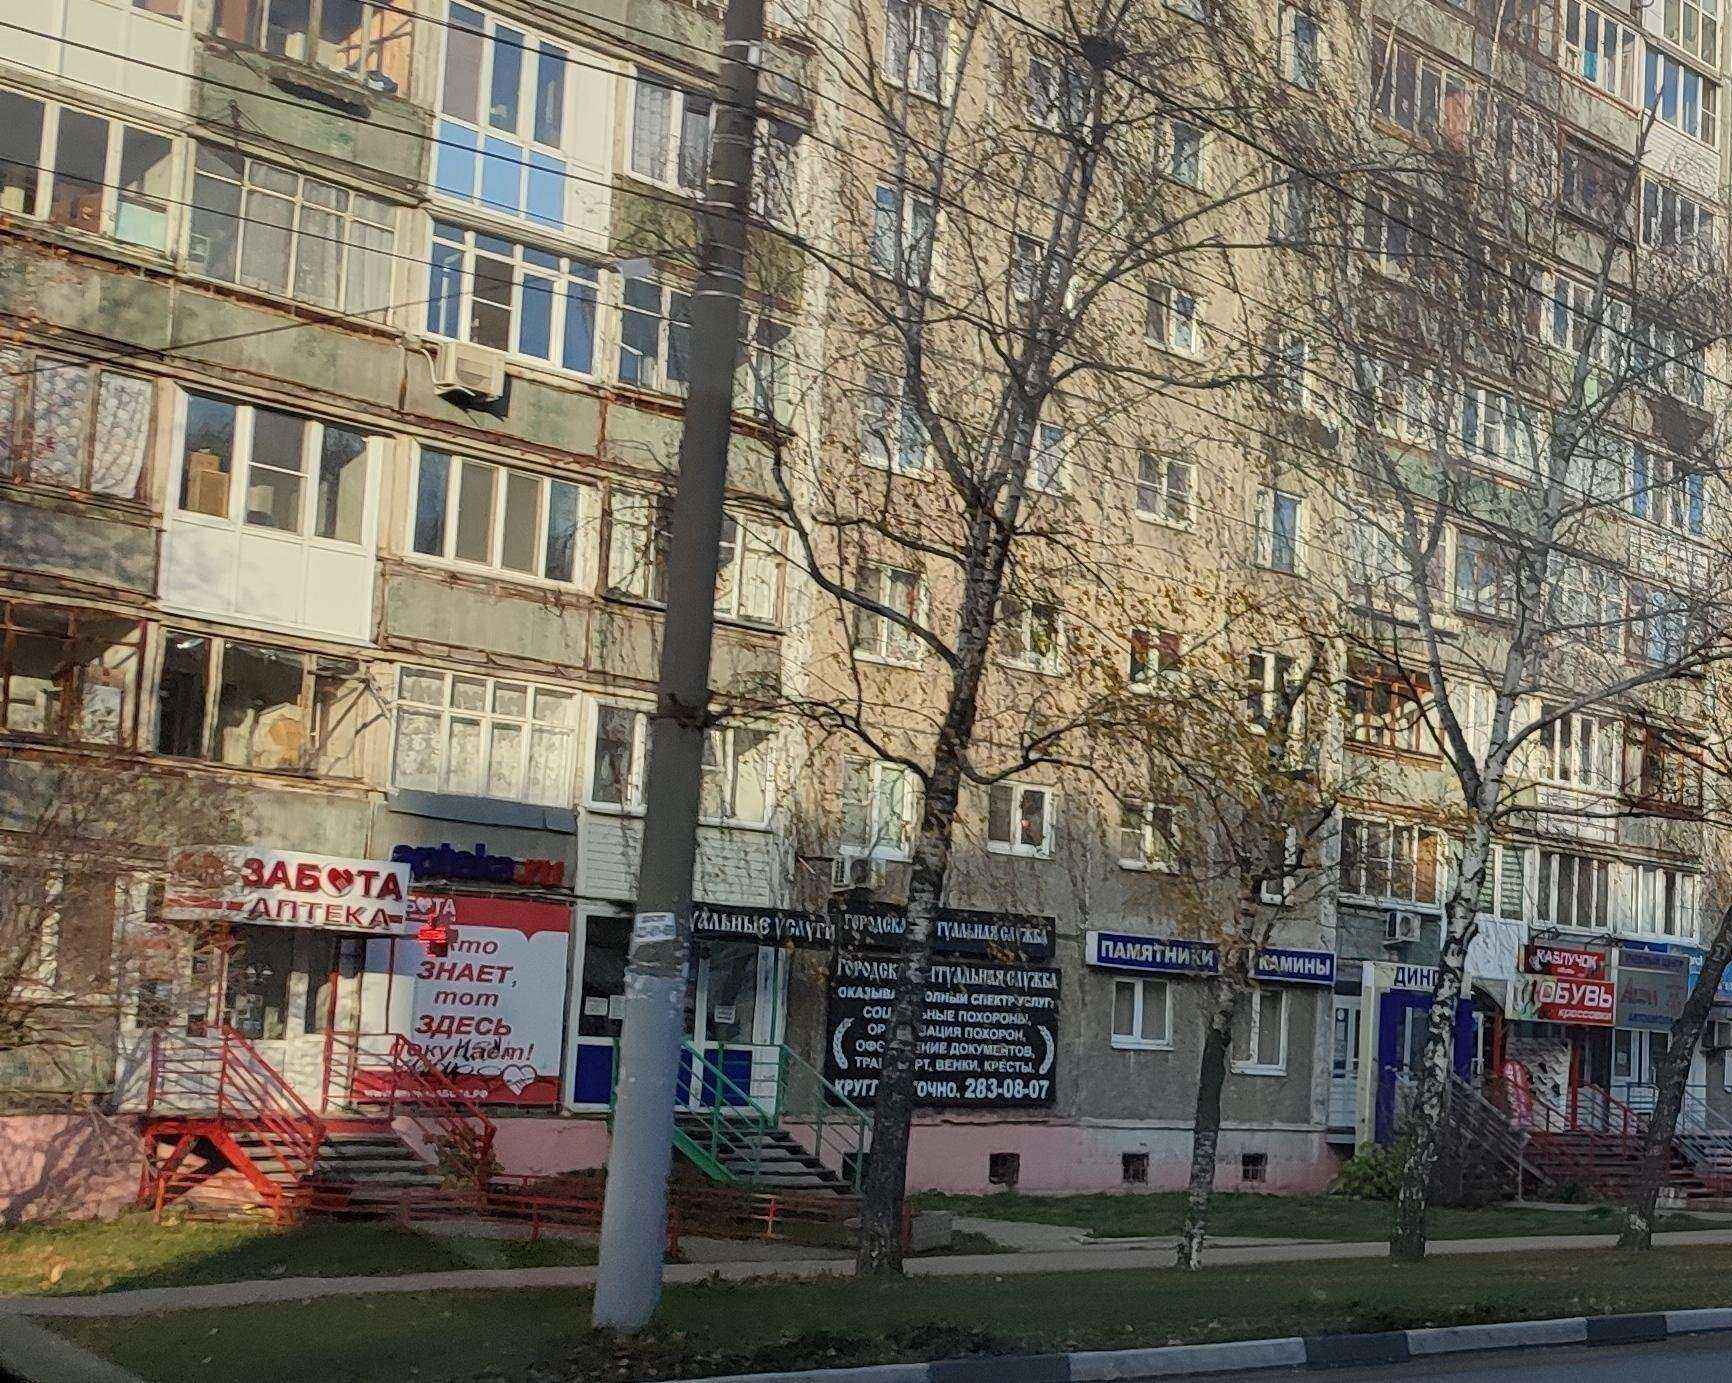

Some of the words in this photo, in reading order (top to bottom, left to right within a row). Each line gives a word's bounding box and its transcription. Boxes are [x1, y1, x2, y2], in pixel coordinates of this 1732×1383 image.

[249, 897, 391, 929] АПТЕКА
[689, 909, 771, 938] УАЛЬНЫЕ
[416, 961, 518, 987] ЗНАЕТ,
[837, 958, 898, 982] ГОРОДСК
[1258, 954, 1331, 976] КАМИНЫ
[434, 990, 500, 1007] тот
[1539, 981, 1613, 1008] ОБУВЬ
[415, 1014, 512, 1039] ЗДЕСЬ
[964, 1078, 1050, 1099] 283-08-07
